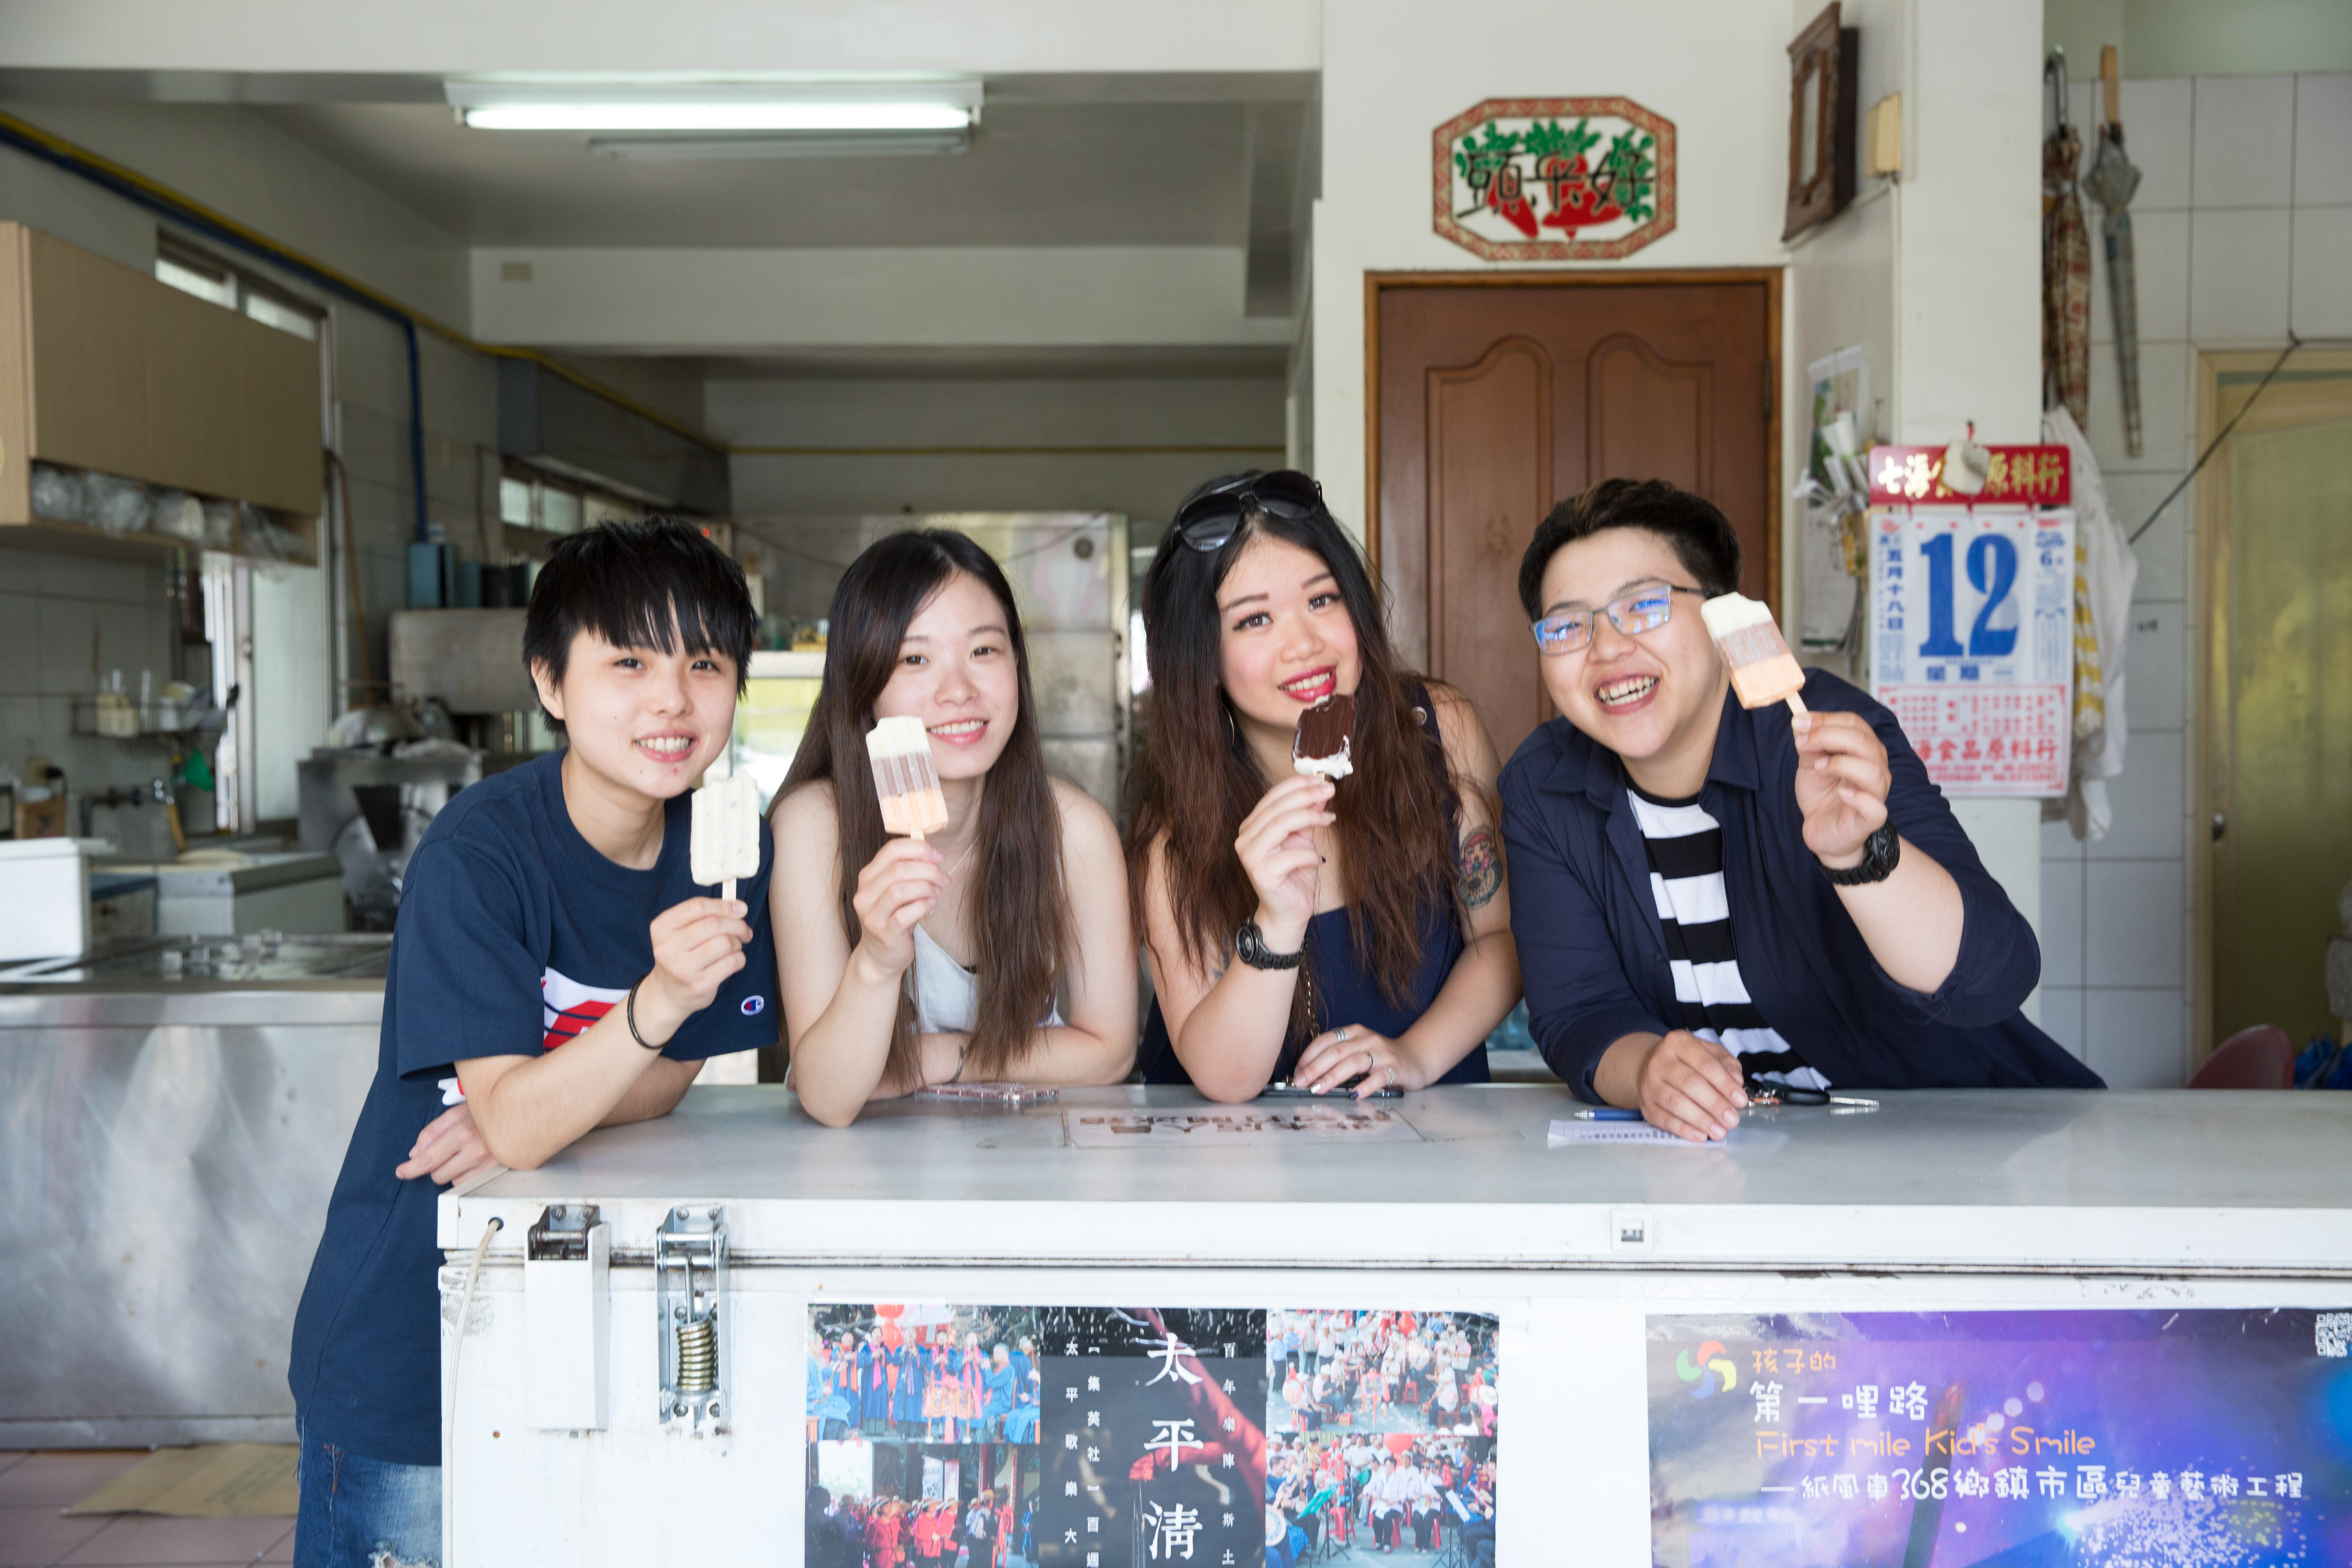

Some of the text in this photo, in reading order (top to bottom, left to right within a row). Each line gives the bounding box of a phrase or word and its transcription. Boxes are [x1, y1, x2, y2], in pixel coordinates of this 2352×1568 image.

[1877, 452, 2065, 499] 七海原料行
[1920, 532, 2019, 657] 12
[1752, 1348, 1836, 1374] 孩子的
[1750, 1380, 1928, 1423] 第一哩路
[1756, 1430, 1839, 1459] First
[1851, 1430, 1910, 1457] mile
[2011, 1426, 2096, 1455] Smile
